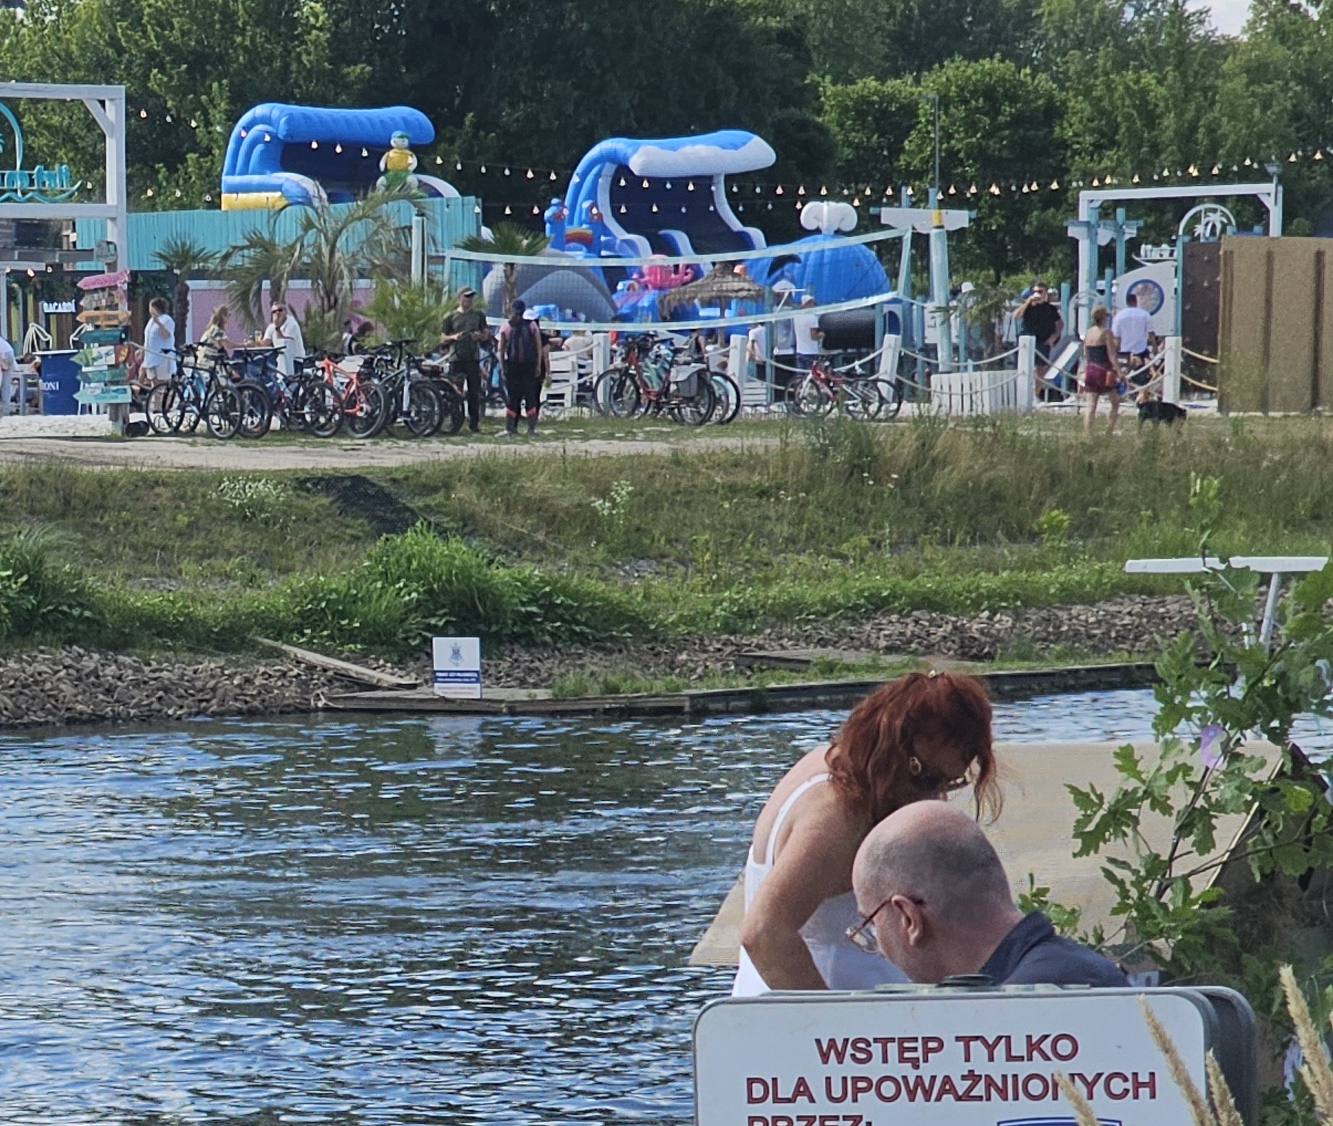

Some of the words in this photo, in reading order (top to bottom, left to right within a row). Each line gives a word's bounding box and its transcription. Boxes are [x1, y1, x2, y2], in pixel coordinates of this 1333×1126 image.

[815, 1036, 944, 1069] WSTĘP
[955, 1034, 1079, 1063] TYLKO
[746, 1076, 815, 1105] DLA
